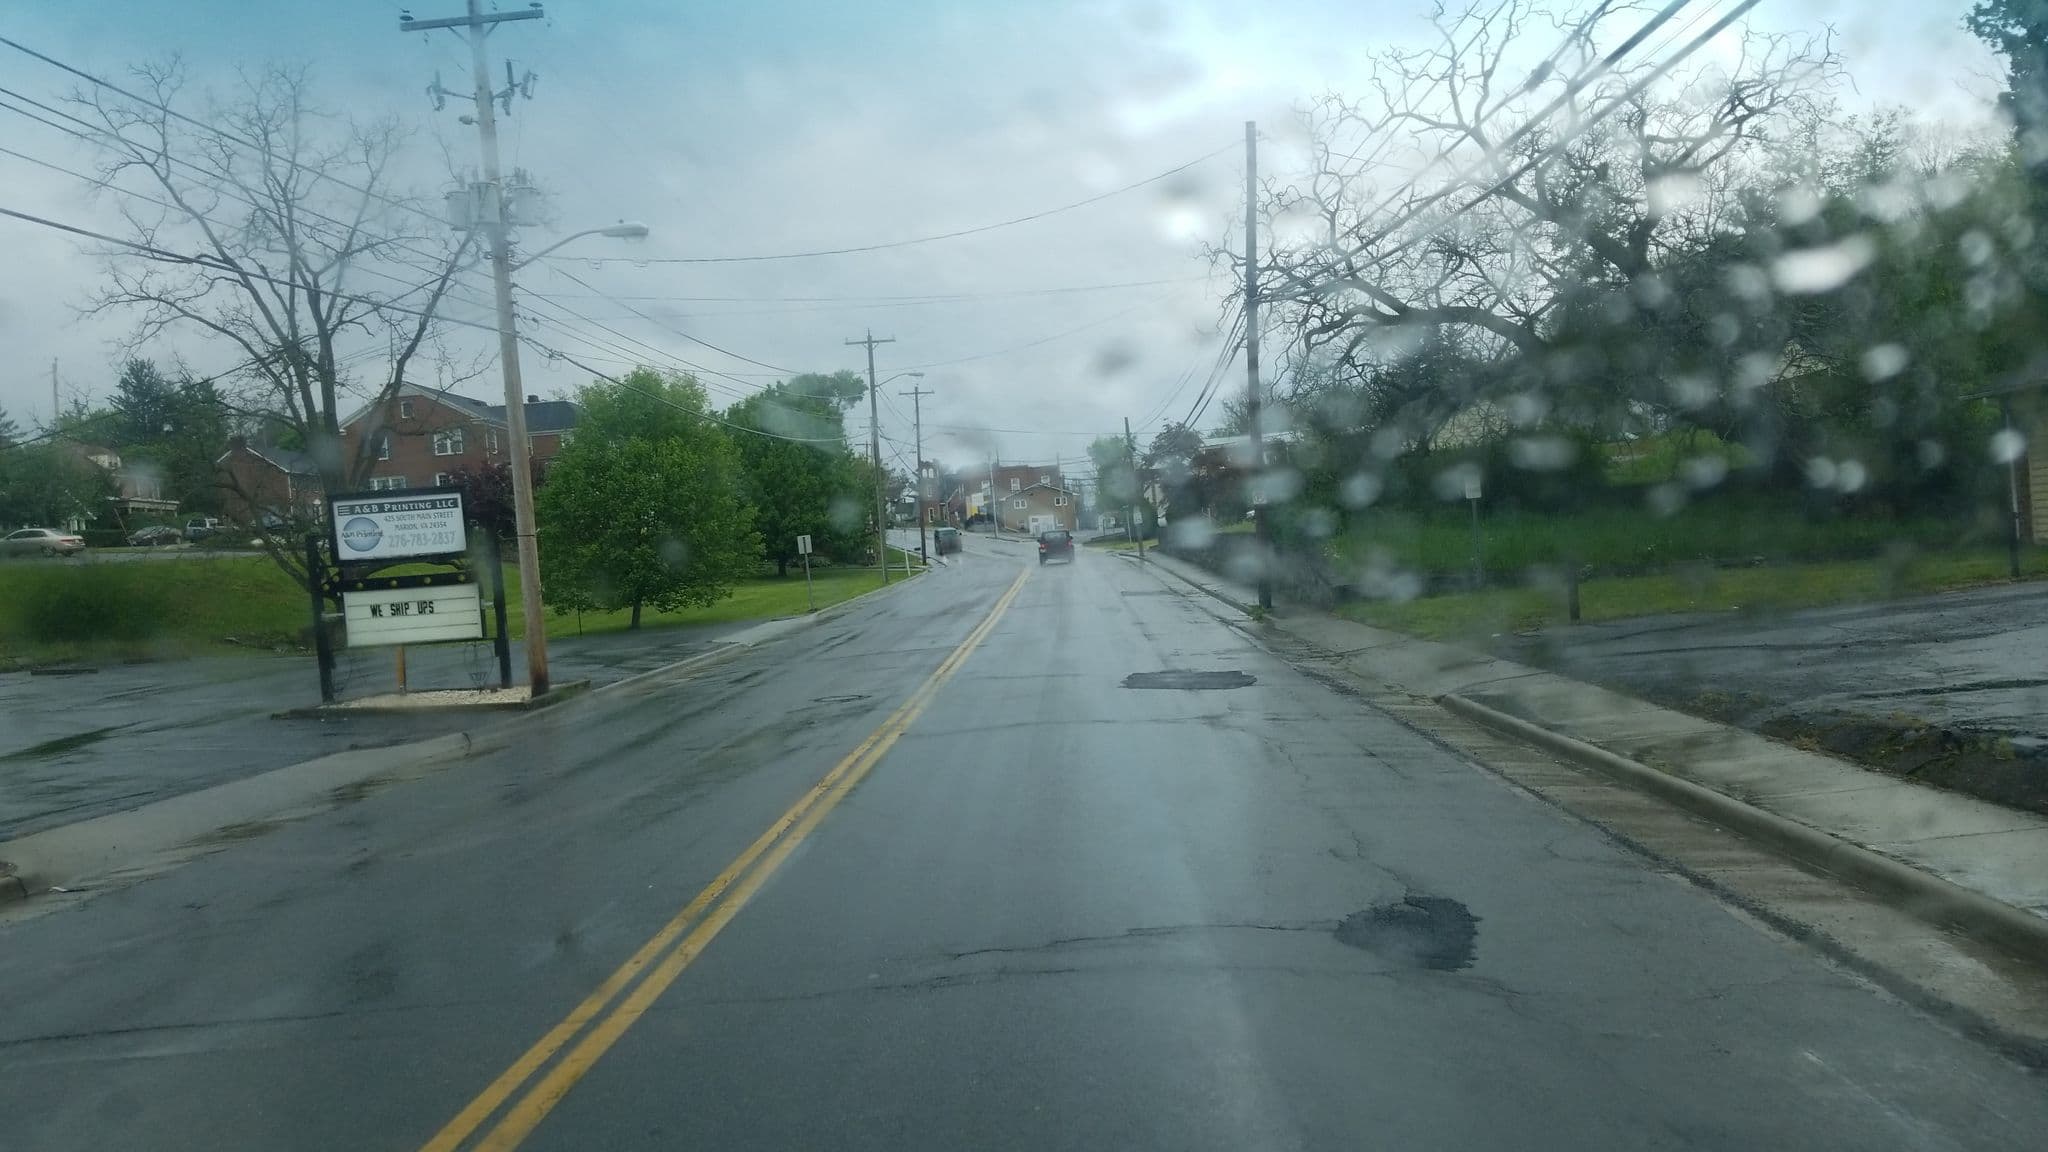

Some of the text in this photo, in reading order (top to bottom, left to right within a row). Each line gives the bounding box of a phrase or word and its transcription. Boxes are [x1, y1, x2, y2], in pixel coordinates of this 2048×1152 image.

[354, 504, 379, 514] A&B
[436, 499, 455, 509] LLC
[396, 513, 416, 522] SOUTH
[417, 512, 432, 520] MAIN
[432, 511, 454, 519] STREET
[429, 521, 448, 529] 24354
[388, 531, 456, 549] 276-783-2837
[370, 600, 435, 618] WE SHIP UPS
